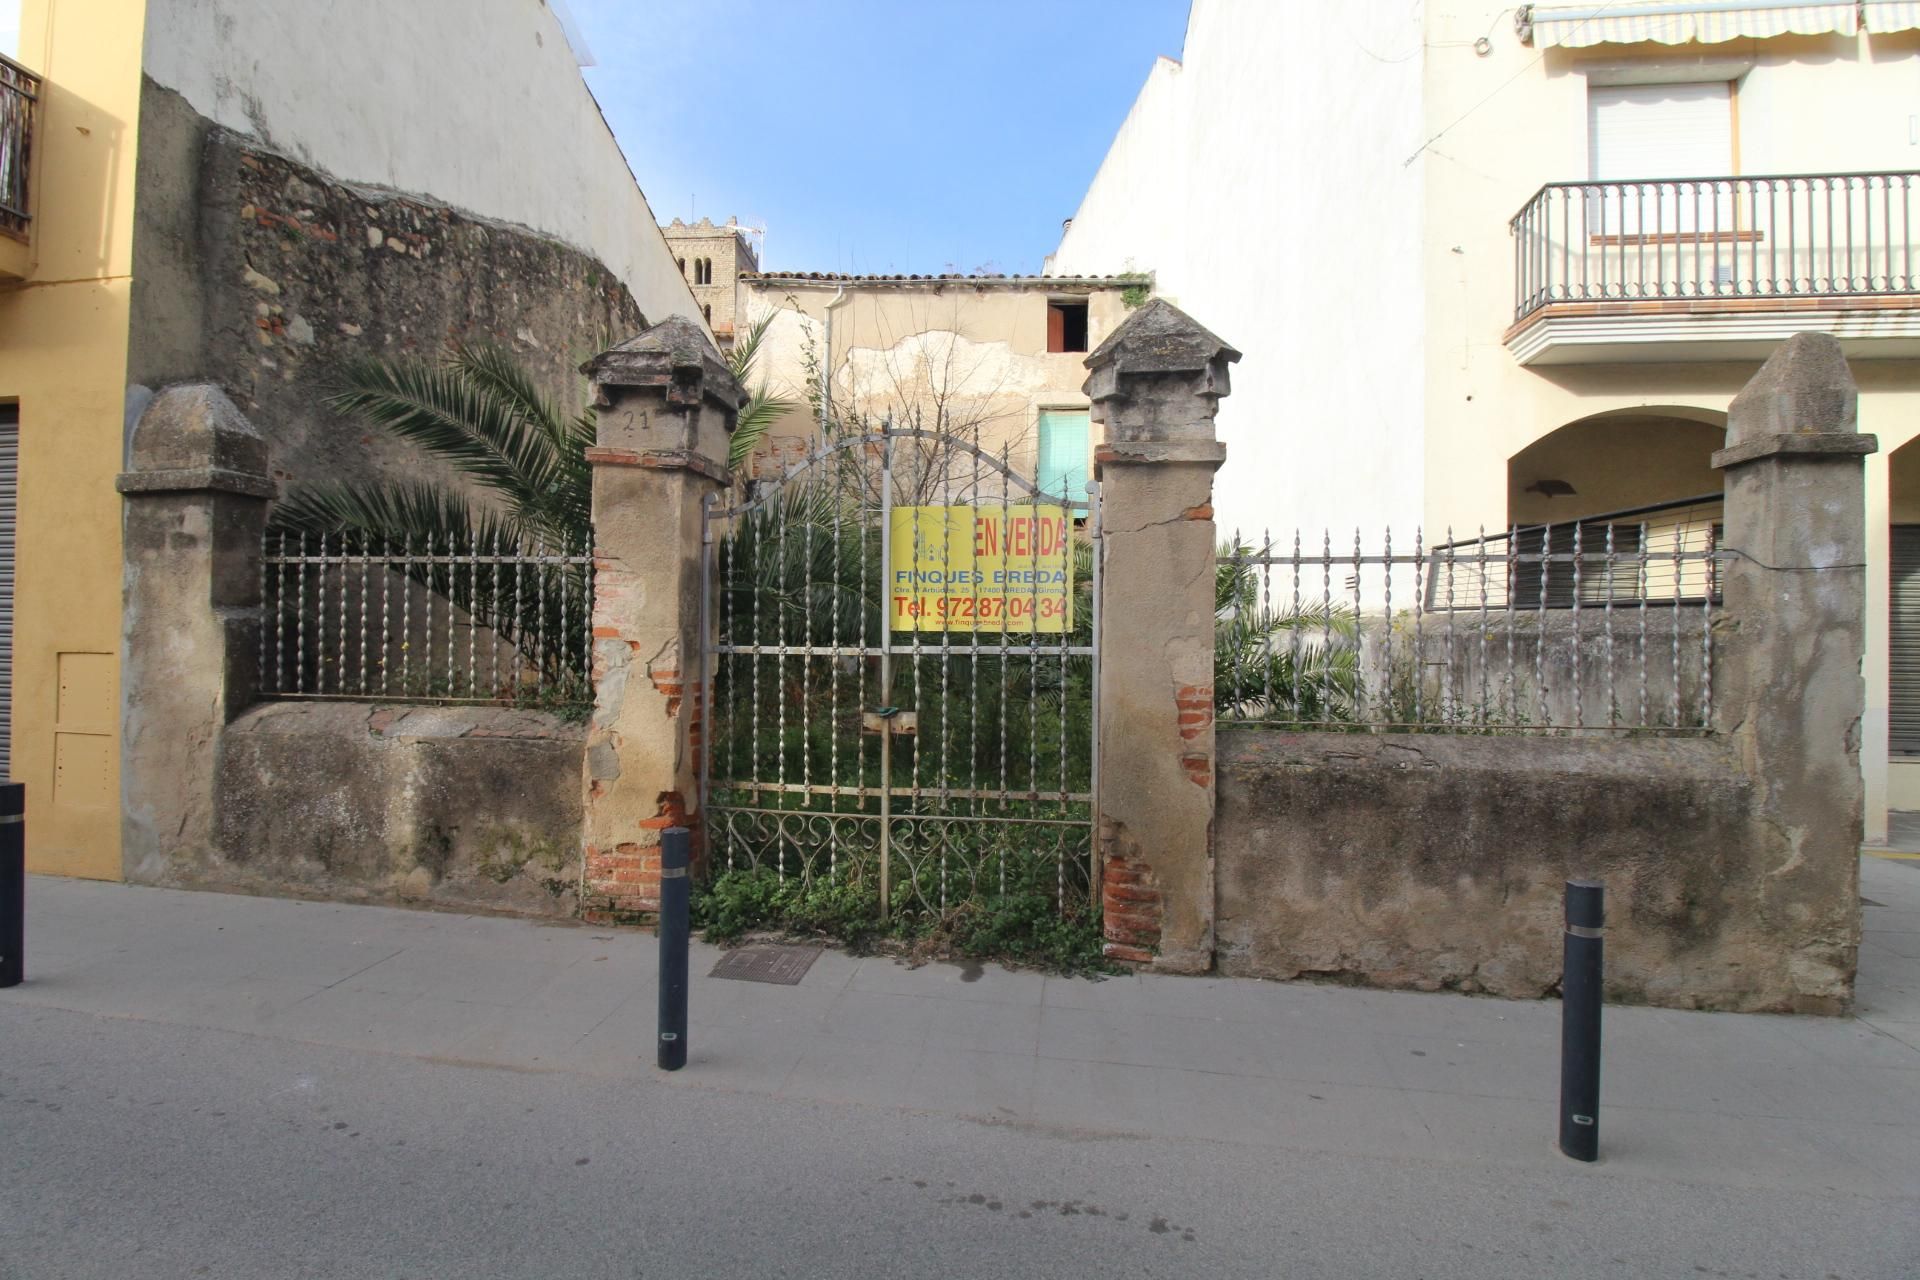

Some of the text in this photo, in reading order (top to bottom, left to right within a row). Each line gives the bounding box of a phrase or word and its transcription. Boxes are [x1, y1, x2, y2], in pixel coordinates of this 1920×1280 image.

[622, 410, 650, 431] 21
[974, 517, 1067, 556] EN VENDA
[895, 570, 1066, 584] FINQUES BREDA
[894, 596, 1067, 618] Tel. 972 87 04 34
